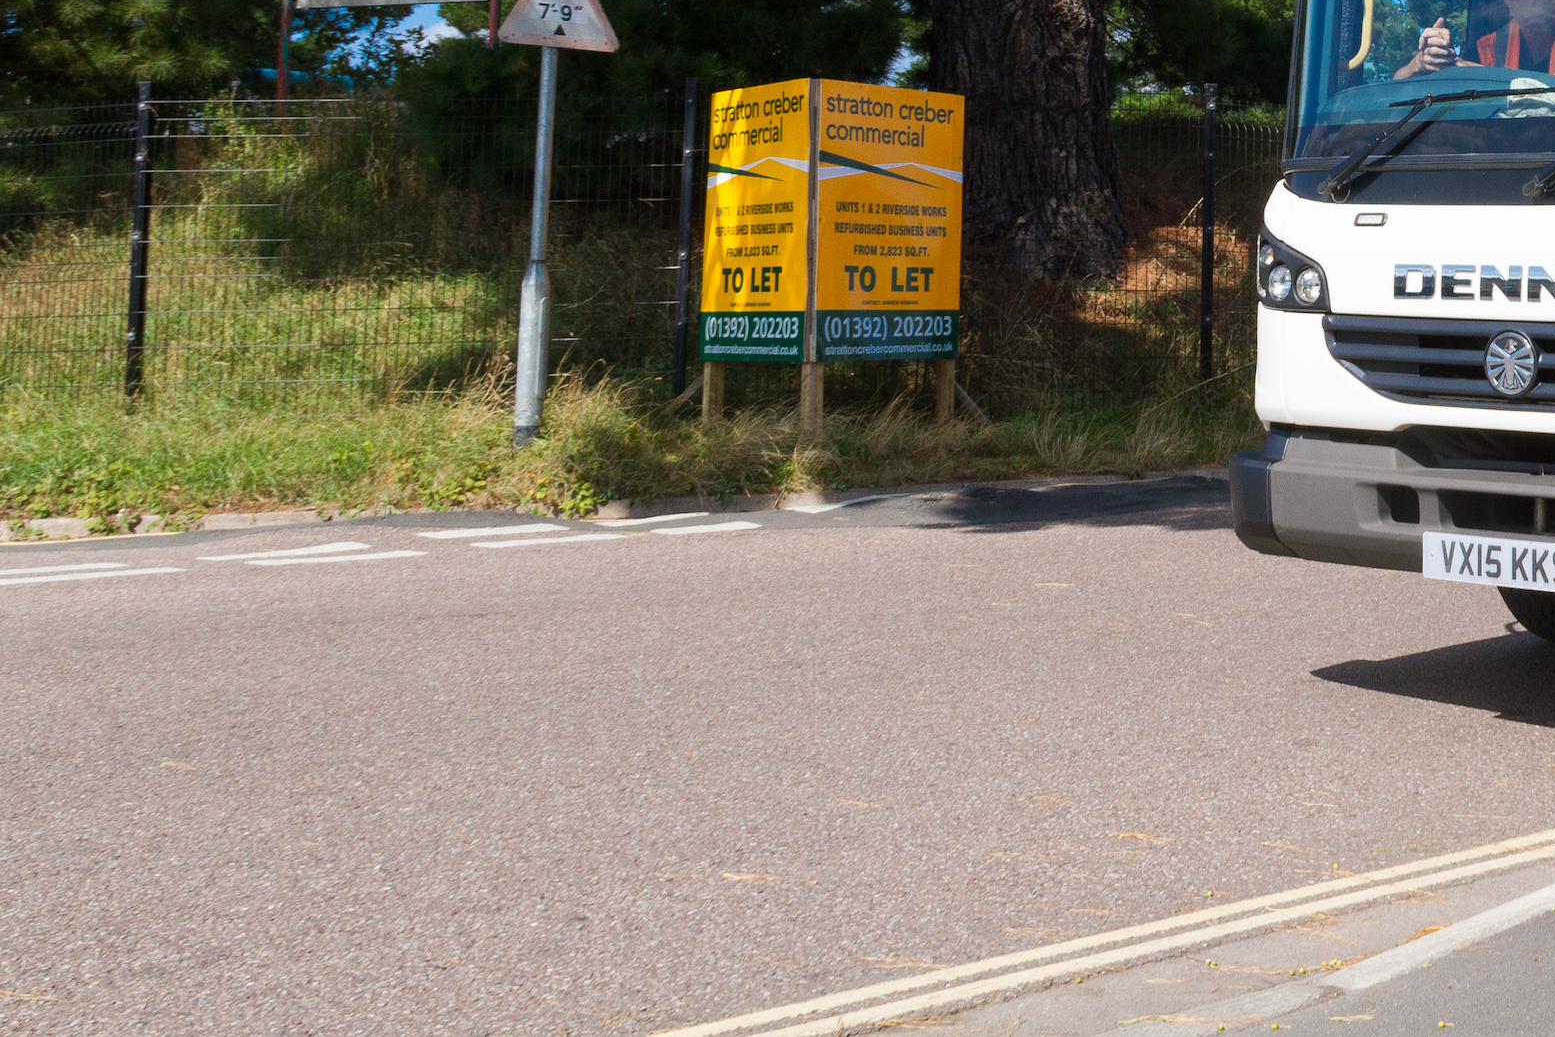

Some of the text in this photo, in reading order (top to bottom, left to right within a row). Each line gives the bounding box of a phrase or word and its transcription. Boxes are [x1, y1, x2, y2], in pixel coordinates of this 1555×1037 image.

[714, 91, 804, 123] stratton creber
[826, 94, 954, 124] stratton creber
[713, 117, 783, 150] commercial
[826, 124, 925, 148] commercial
[774, 201, 794, 213] WORKS
[835, 201, 947, 217] UNITS 1 & 2 RIVERSIDE WORKS
[750, 223, 776, 235] BUSINESS
[777, 222, 794, 234] UNITS
[835, 222, 947, 237] REFURBISHED BUSINESS UNITS
[726, 247, 743, 258] FROM
[854, 245, 930, 258] FROM 2,823 SQ.FT.
[722, 266, 783, 293] TO LET
[844, 265, 934, 292] TO LET
[705, 316, 799, 341] (01392) 202203
[824, 315, 953, 343] (01392) 202203
[704, 344, 799, 355] strattoncrebercommercial.co.uk
[825, 341, 953, 356] strattoncrebercommercial.co.uk
[1441, 540, 1501, 578] VX15
